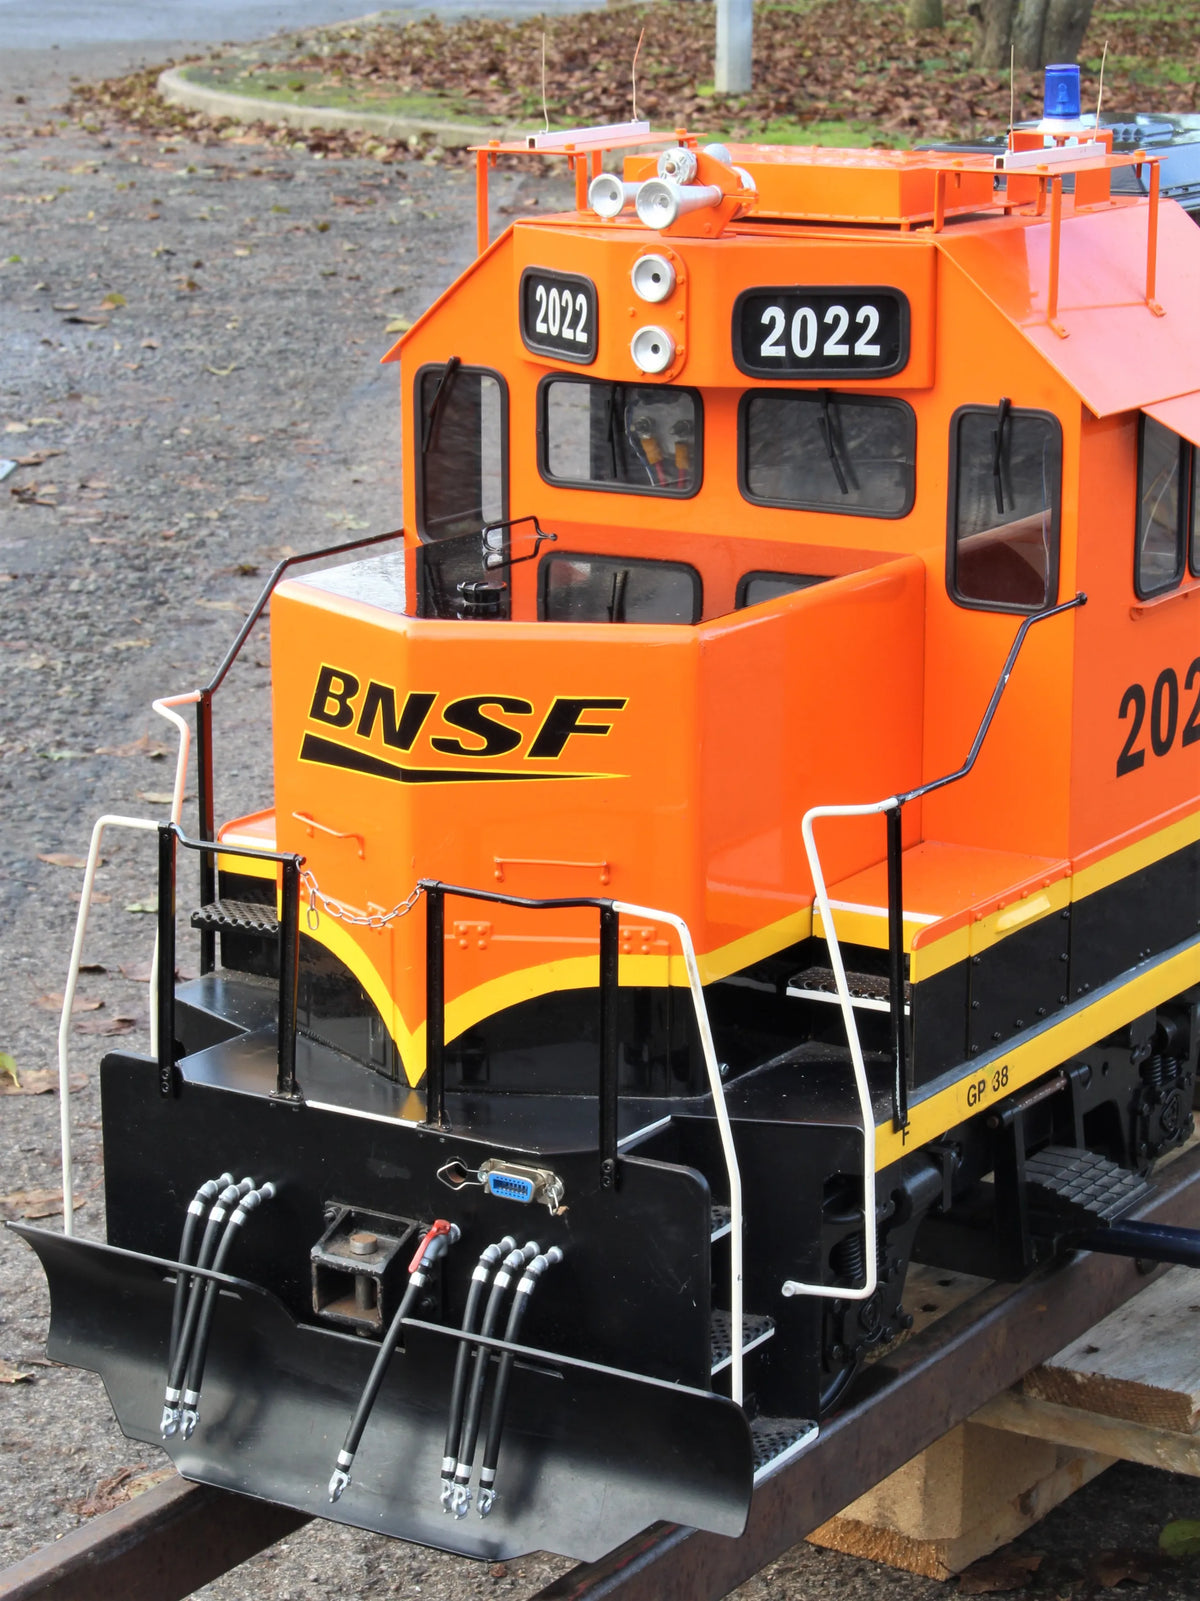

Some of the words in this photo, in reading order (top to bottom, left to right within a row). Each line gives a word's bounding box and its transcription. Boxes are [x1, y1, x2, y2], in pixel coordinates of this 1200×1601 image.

[535, 284, 588, 343] 2022
[760, 305, 881, 358] 2022
[307, 662, 630, 759] BNSF
[967, 1079, 986, 1107] GP
[992, 1065, 1009, 1092] 38
[902, 1121, 911, 1146] F
